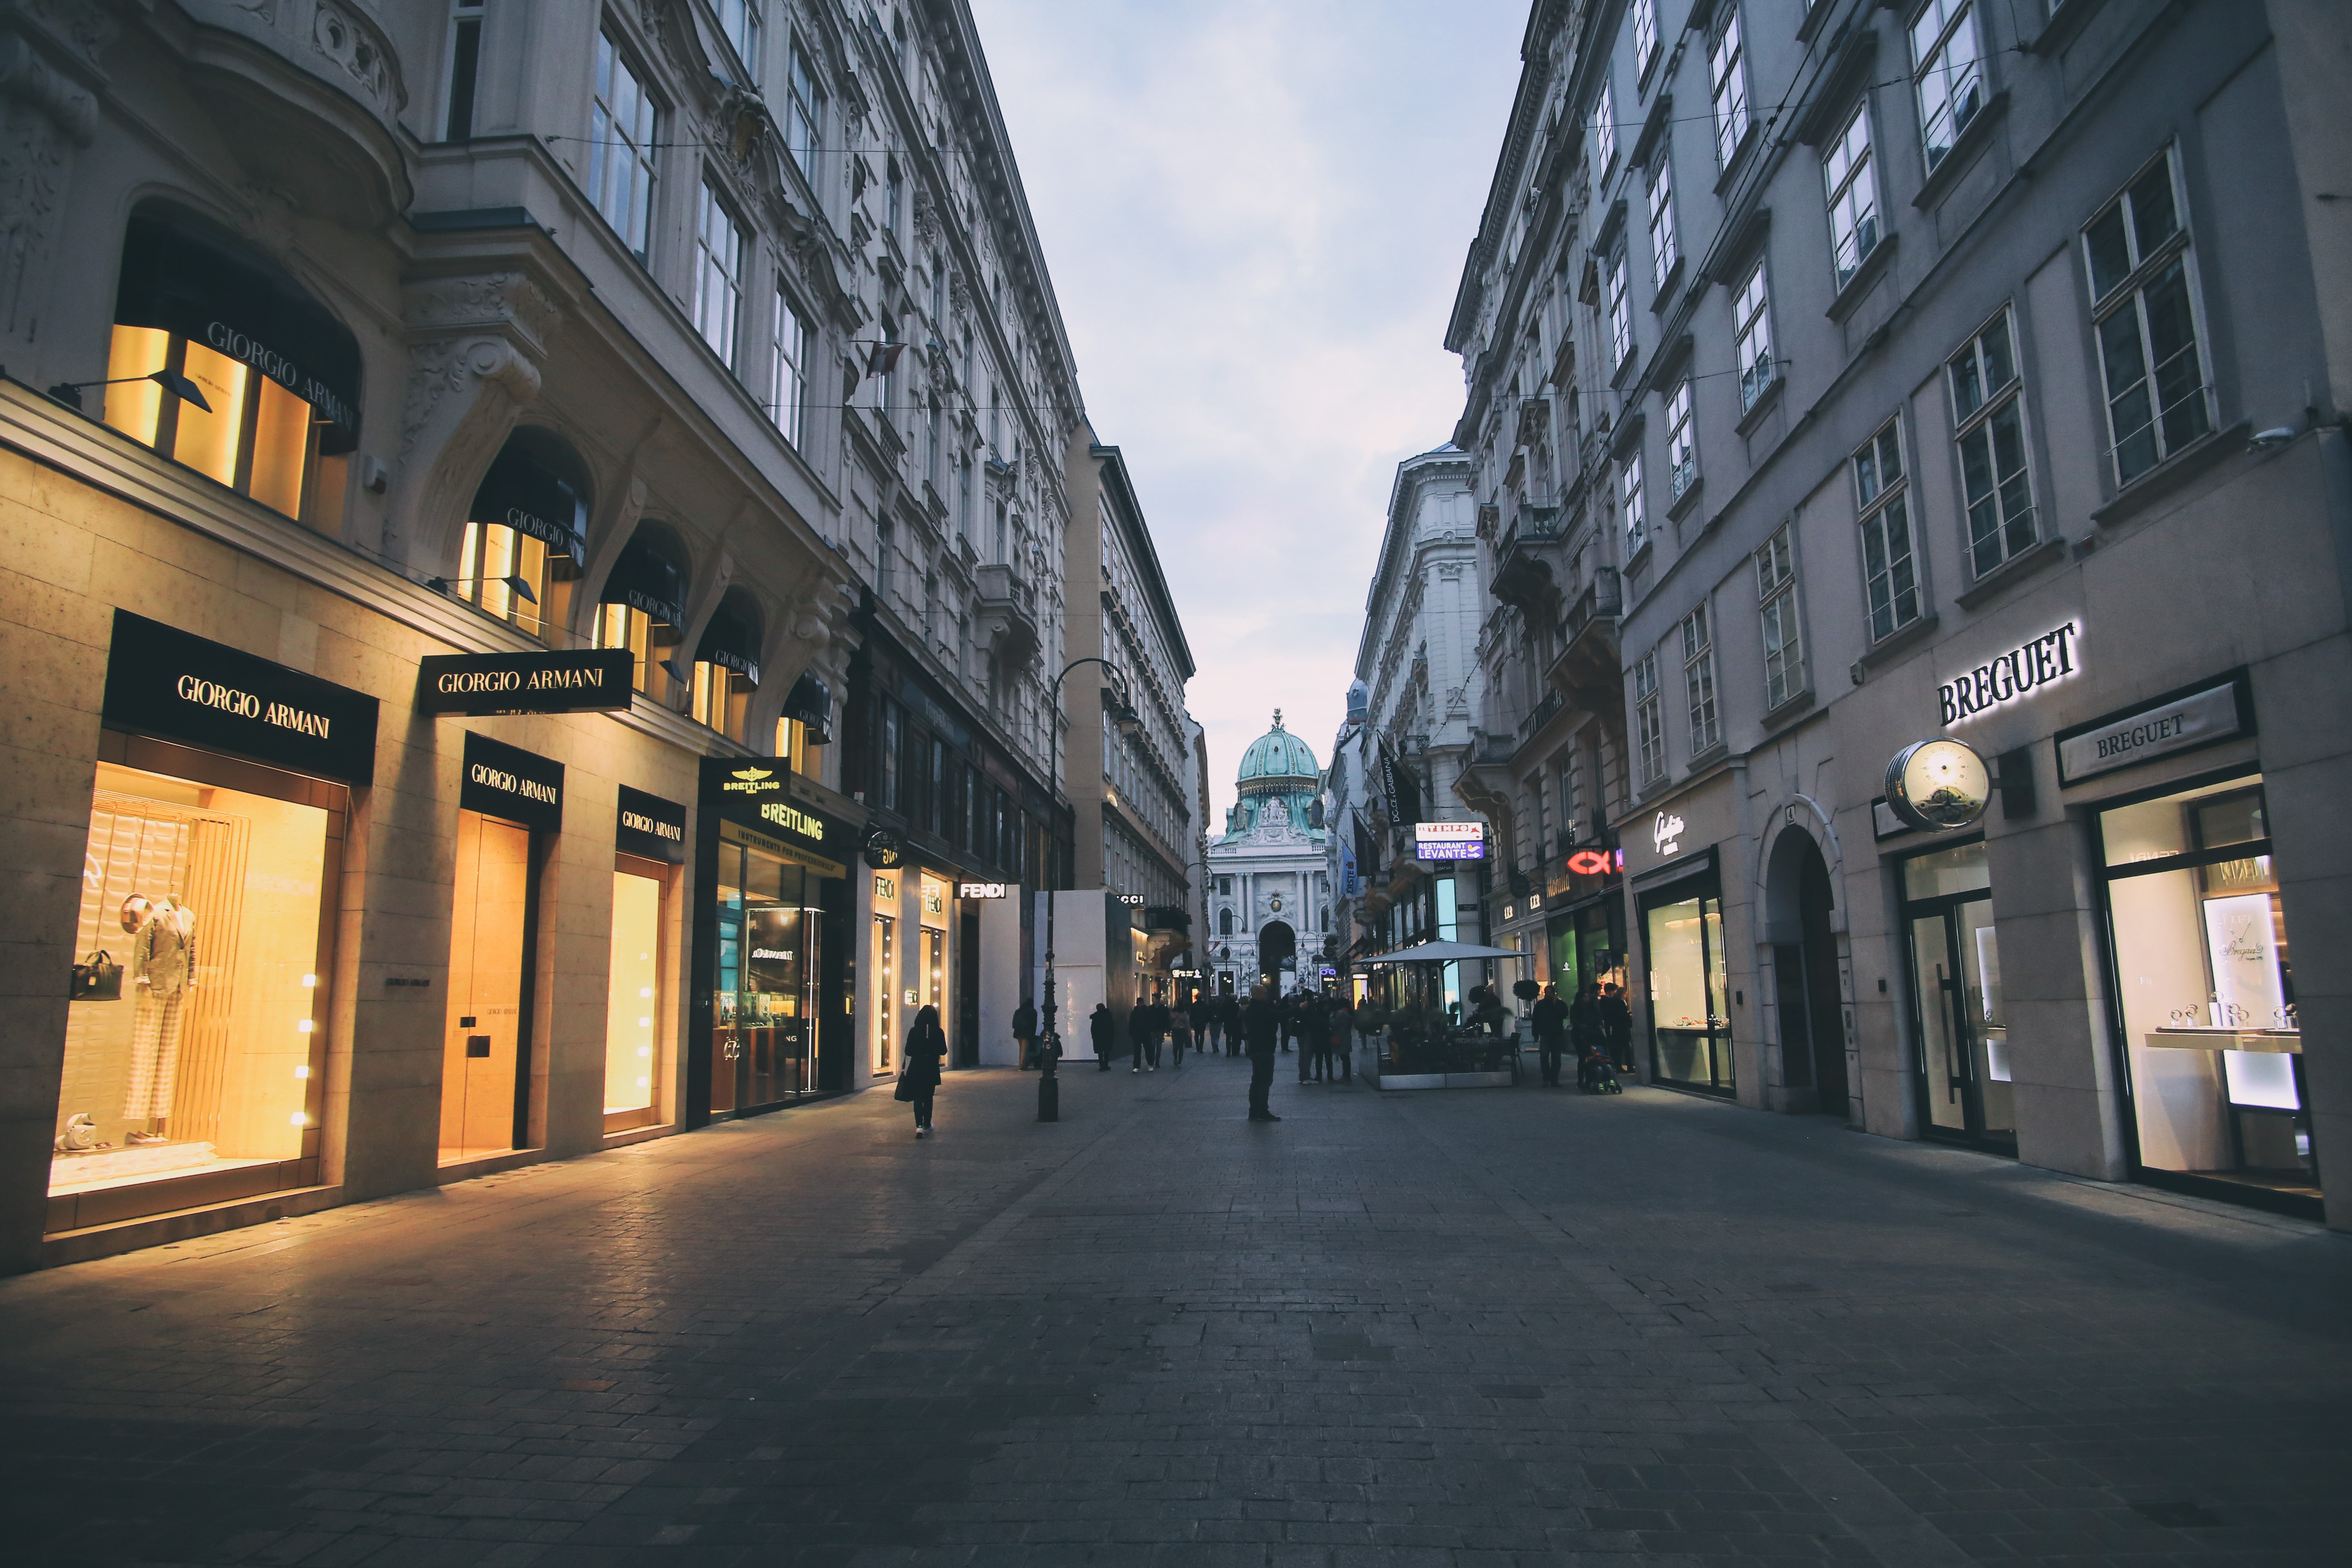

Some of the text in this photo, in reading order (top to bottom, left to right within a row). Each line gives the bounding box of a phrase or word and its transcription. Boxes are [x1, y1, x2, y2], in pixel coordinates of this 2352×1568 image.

[207, 322, 296, 386] GIORGIO
[508, 508, 563, 546] GIORGIO
[629, 590, 670, 620] GIORGIO
[716, 649, 751, 673] GIORGIO
[1937, 622, 2076, 727] BREGUET
[438, 668, 604, 693] GIORGIO ARMANI
[178, 674, 331, 739] GIORGIO ARMANI
[2097, 713, 2184, 759] BREGUET
[471, 763, 556, 805] GIORGIO ARMANI
[723, 781, 780, 791] BREITLING
[1384, 756, 1395, 794] GABBANA
[622, 811, 681, 842] GIORGIO ARMANI
[761, 803, 823, 840] BREITLING
[738, 829, 780, 853] INSTRUMENTS
[782, 846, 793, 857] FOR
[1418, 849, 1467, 859] LEVANTE
[960, 883, 1005, 898] FENDI
[1347, 870, 1355, 893] ERSTE
